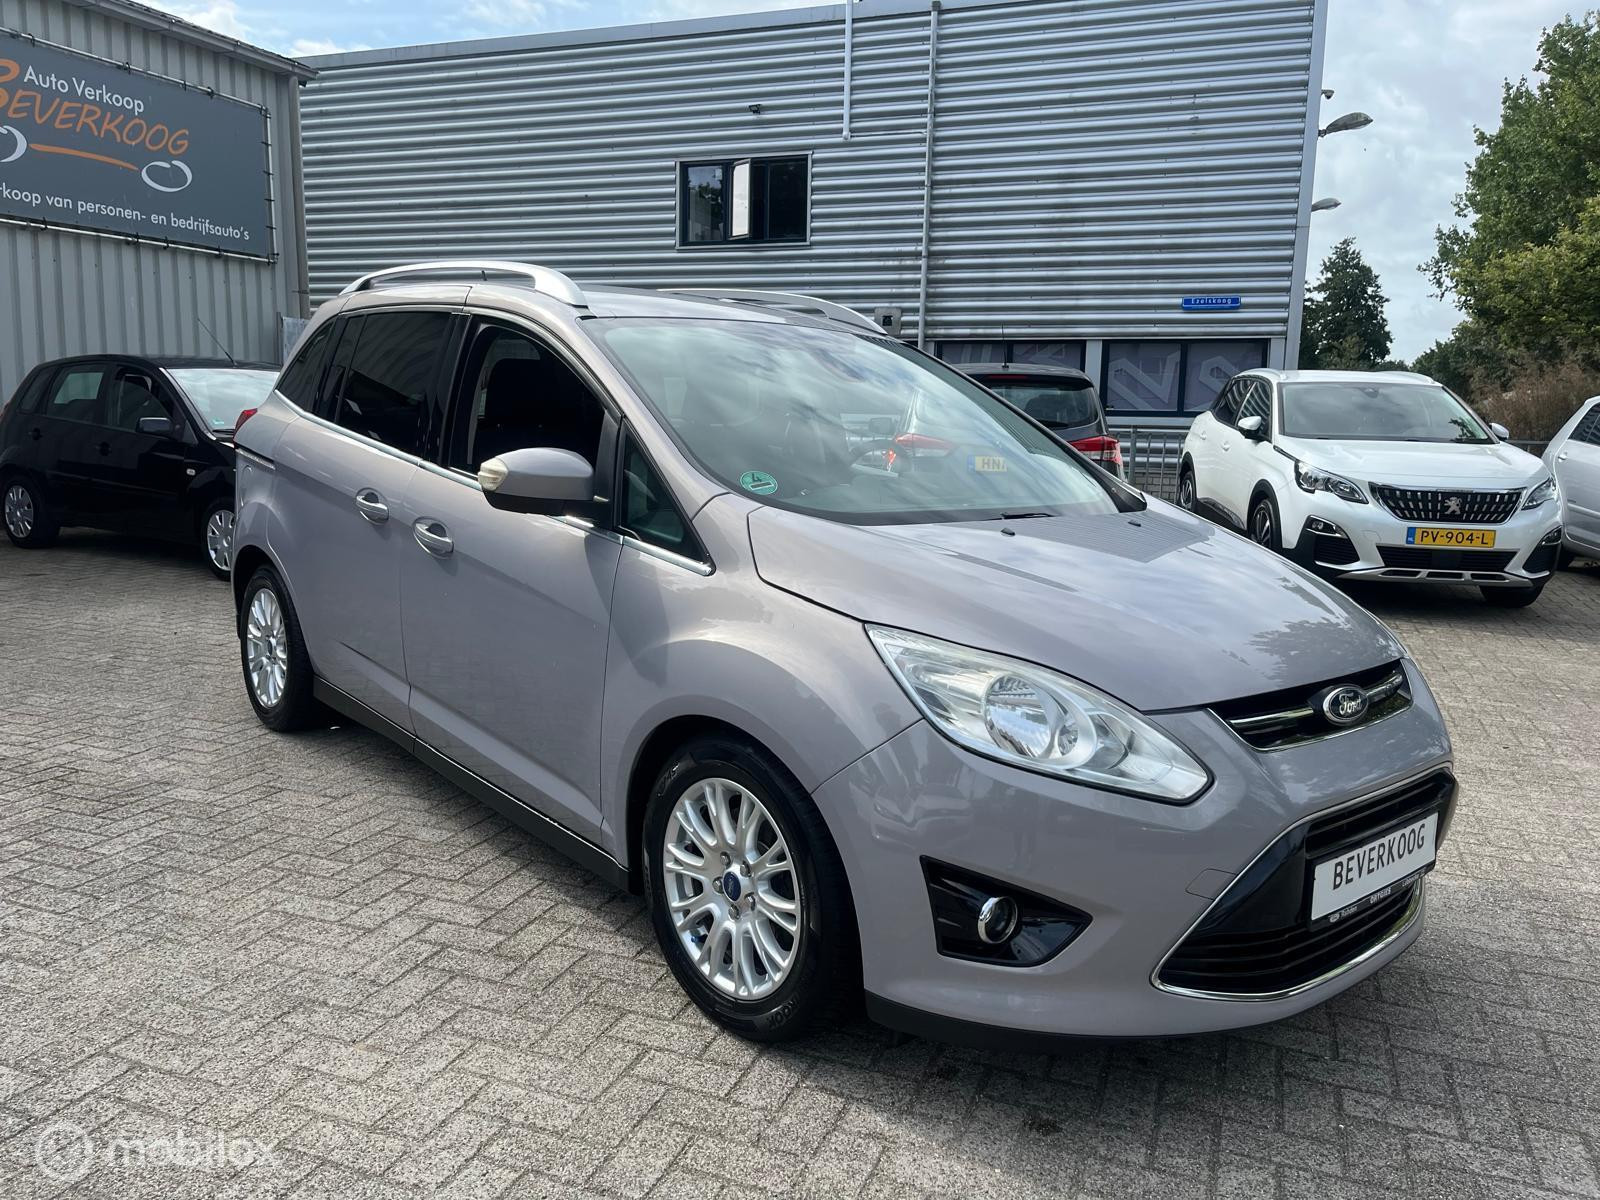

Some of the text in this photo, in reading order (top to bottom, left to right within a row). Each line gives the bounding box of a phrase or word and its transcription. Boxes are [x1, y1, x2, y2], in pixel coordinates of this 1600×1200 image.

[23, 65, 145, 116] Auto Verkoop
[0, 182, 250, 240] koop van personen- en bedrijfsauto's
[1420, 530, 1489, 545] PV-904-L
[1339, 692, 1362, 716] Ford
[1332, 823, 1426, 891] BEVERKOOG
